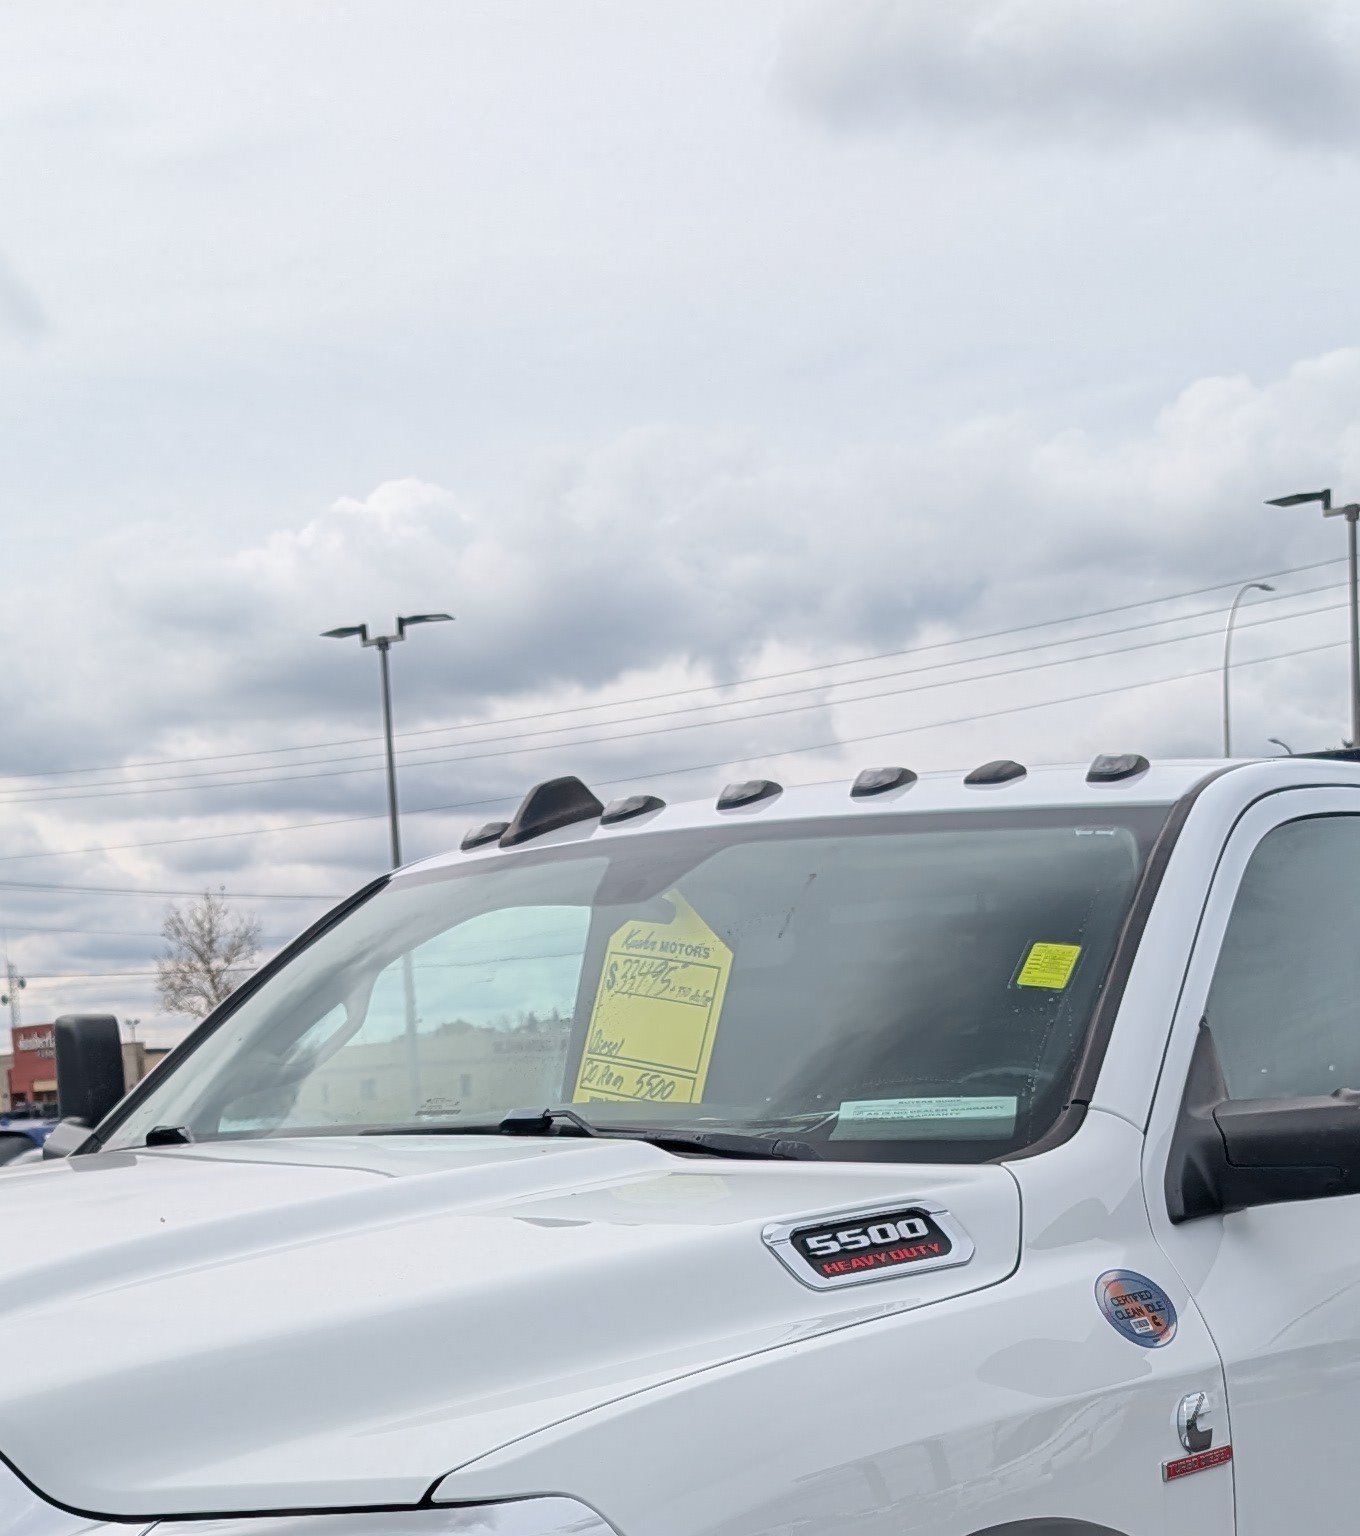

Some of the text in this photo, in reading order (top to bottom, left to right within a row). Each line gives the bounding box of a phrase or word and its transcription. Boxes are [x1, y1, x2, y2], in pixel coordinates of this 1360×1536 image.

[660, 942, 710, 959] MOTORS
[633, 1072, 676, 1101] 5500
[806, 1217, 929, 1256] 5500
[823, 1243, 940, 1274] HEAVY DUTY
[1110, 1290, 1153, 1306] CERTIFIED
[1115, 1300, 1165, 1320] CLEAN IDLE
